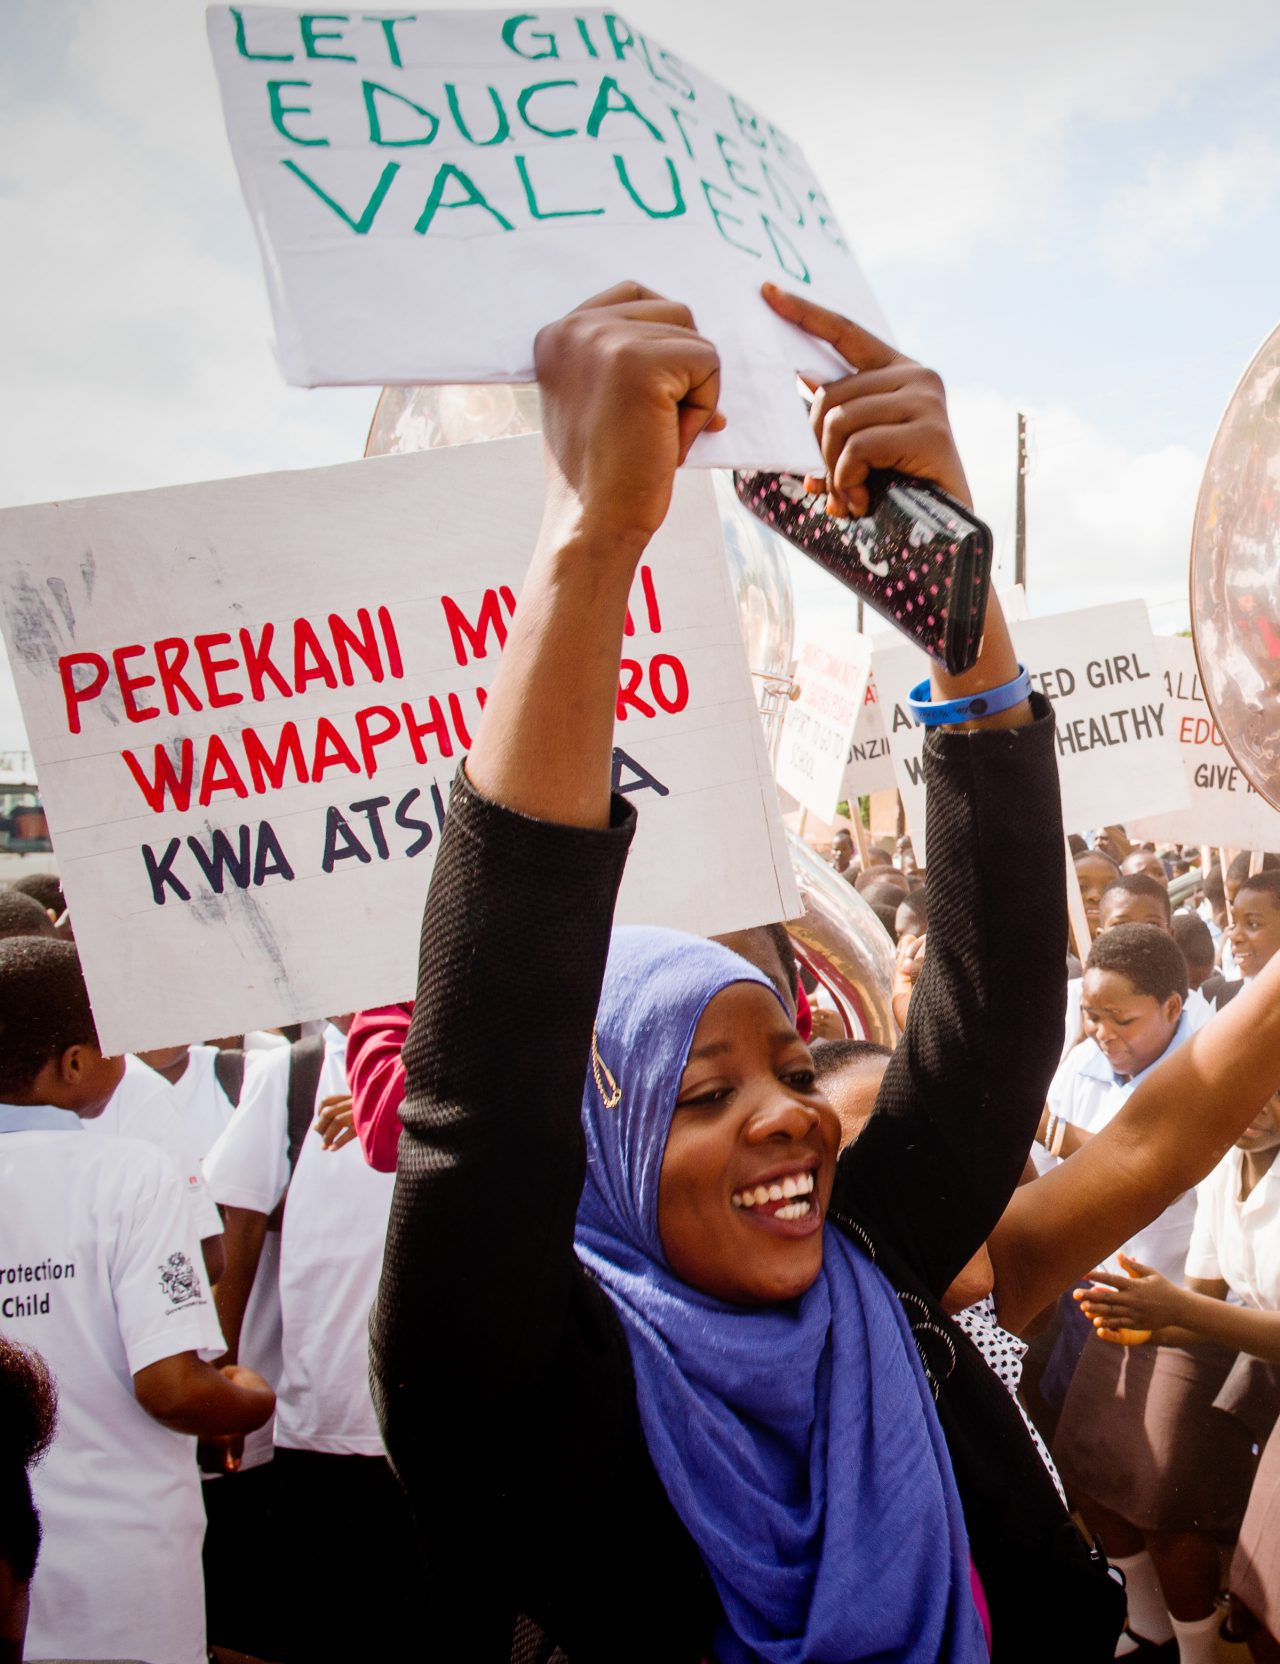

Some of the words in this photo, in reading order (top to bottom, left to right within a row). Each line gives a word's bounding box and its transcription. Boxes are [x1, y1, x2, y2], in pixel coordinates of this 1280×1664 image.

[229, 6, 417, 68] LET
[501, 13, 697, 102] GIRLS
[266, 76, 805, 227] EDUCATED
[281, 154, 812, 285] VALUED
[58, 605, 404, 734] PEREKANI
[1086, 653, 1150, 690] GIRL
[1056, 703, 1165, 756] HEALTHY
[1194, 763, 1239, 792] GIVE
[141, 820, 295, 905] KWA
[2, 1292, 50, 1318] Child
